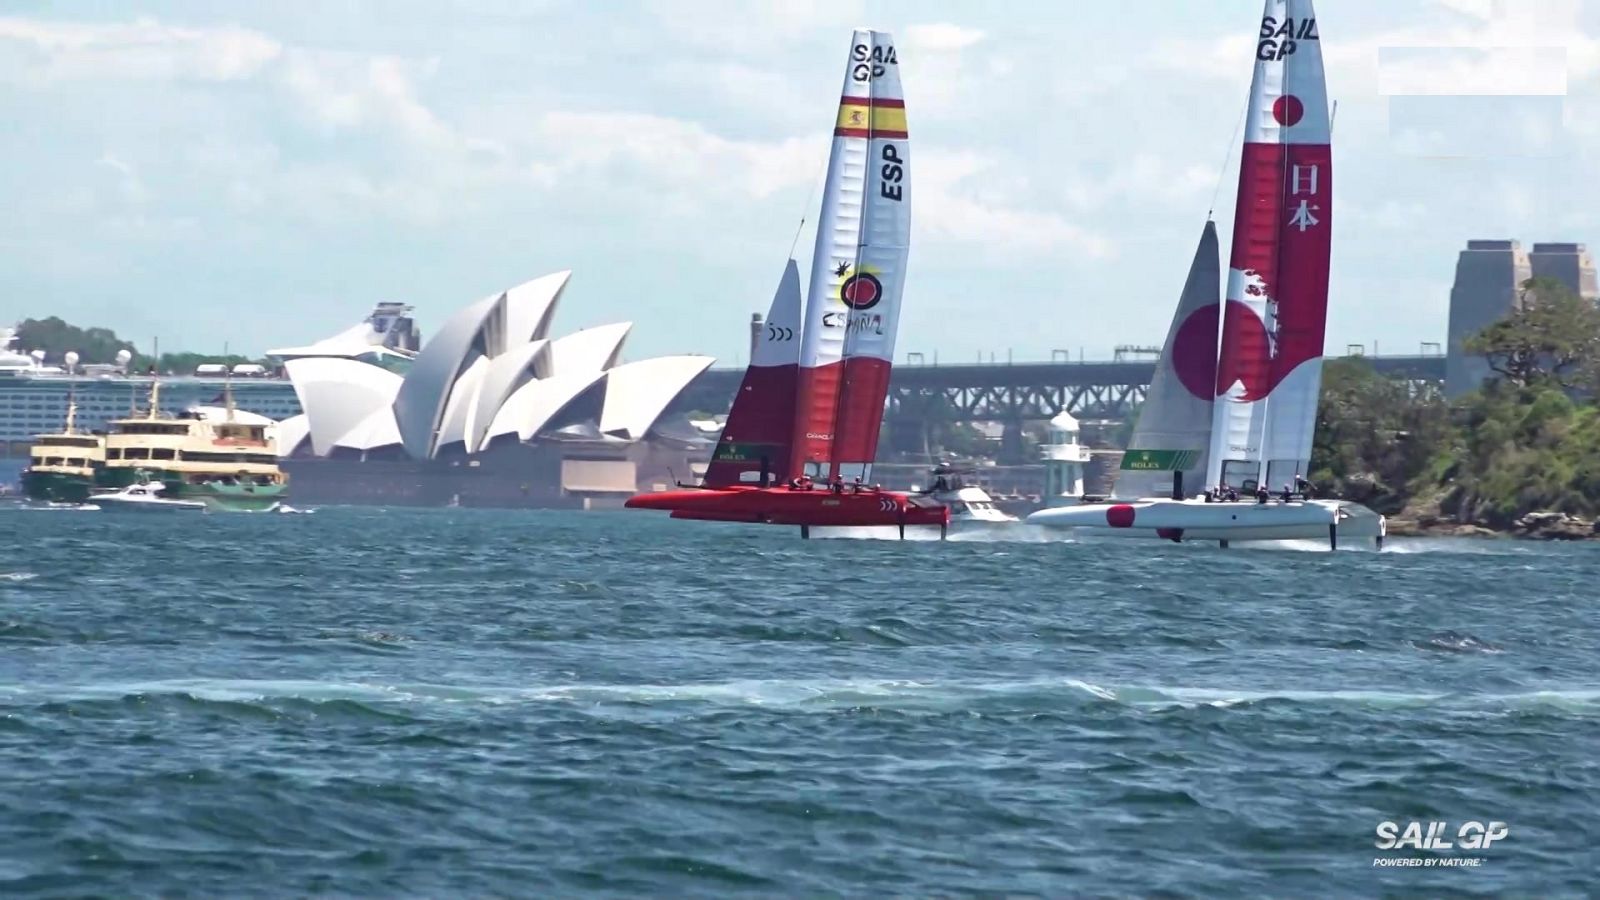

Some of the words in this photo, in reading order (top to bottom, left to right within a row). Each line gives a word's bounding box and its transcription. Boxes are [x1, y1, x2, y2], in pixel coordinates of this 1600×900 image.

[1260, 16, 1319, 40] SAIL
[852, 44, 898, 64] SAIL
[1256, 39, 1297, 61] GP
[852, 64, 885, 83] GP
[881, 143, 903, 201] ESP
[1287, 164, 1320, 232] 日本
